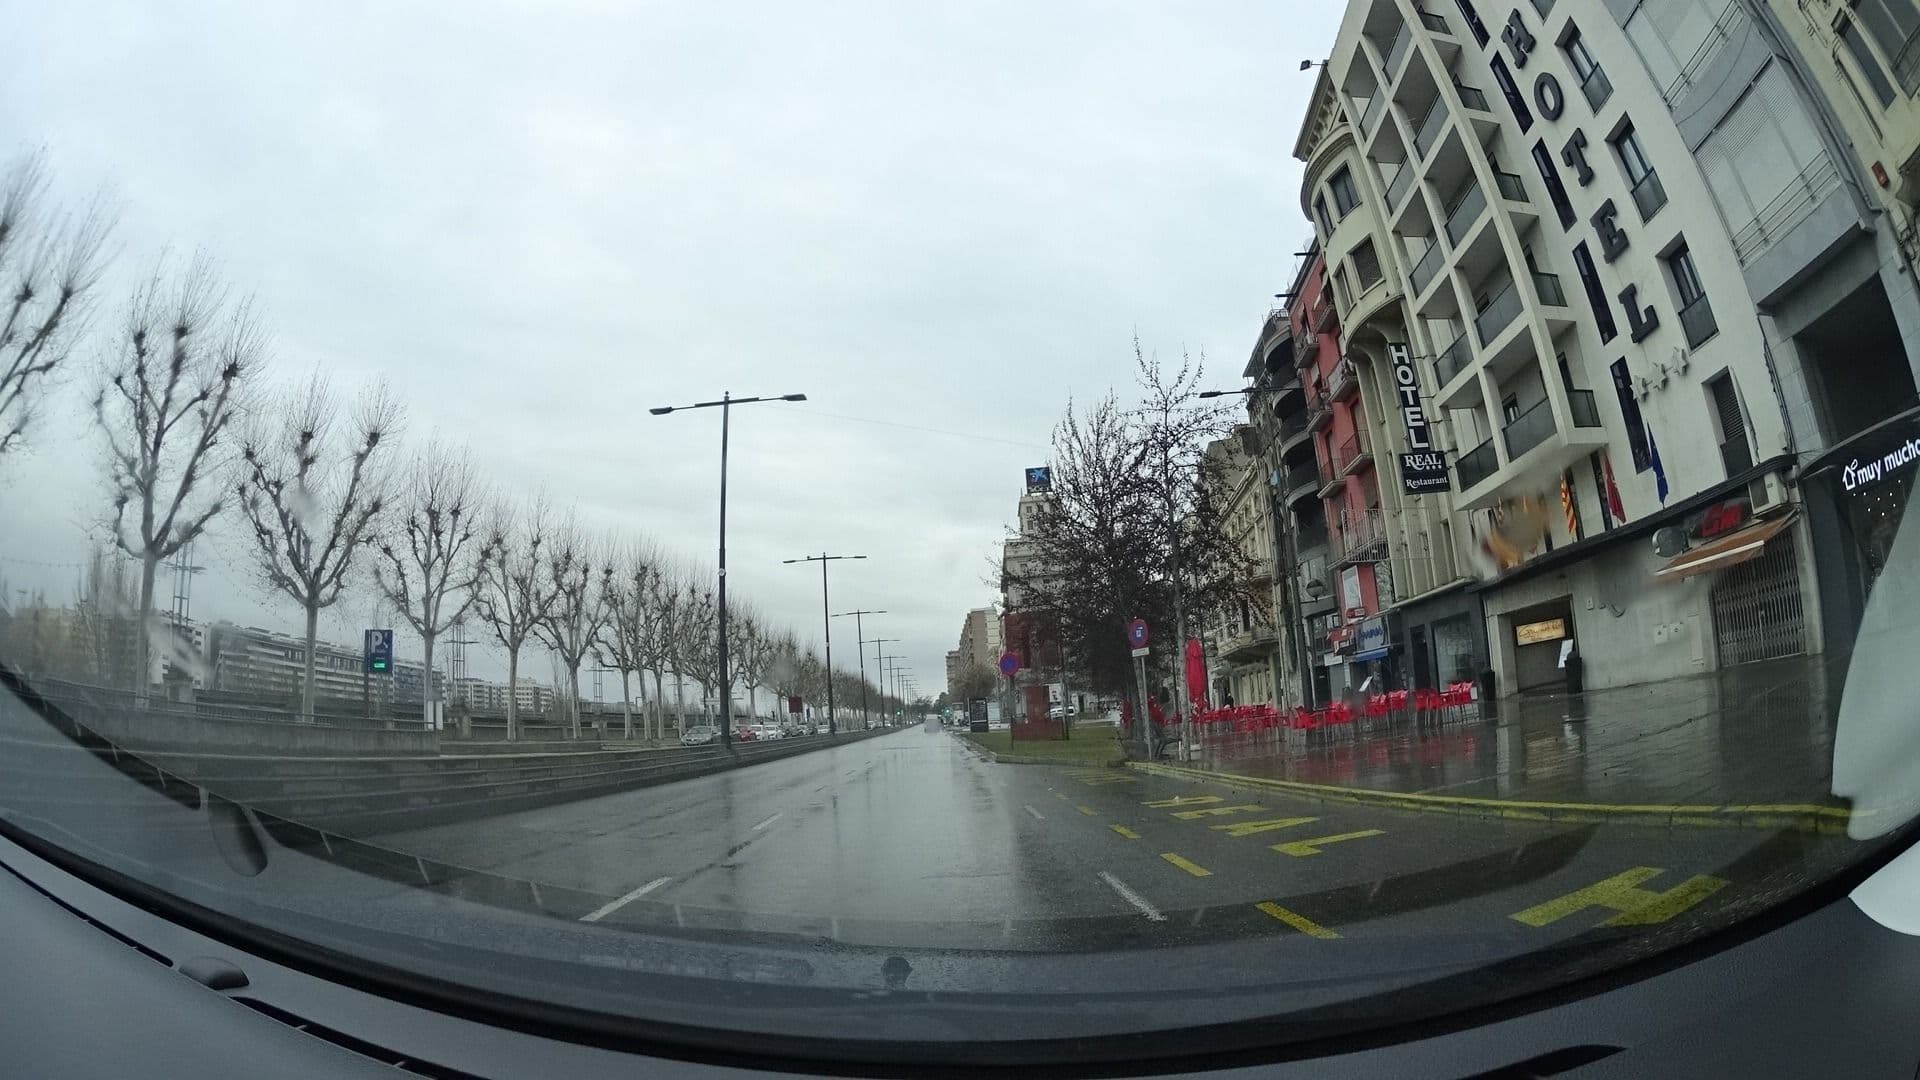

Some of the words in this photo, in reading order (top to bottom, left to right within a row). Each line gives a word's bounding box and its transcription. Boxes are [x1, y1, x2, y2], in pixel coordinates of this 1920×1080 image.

[1501, 8, 1659, 343] HOTEL
[1390, 345, 1429, 449] HOTEL
[1404, 453, 1442, 470] REAL
[1857, 459, 1881, 485] muy
[1406, 476, 1449, 489] Restaurant
